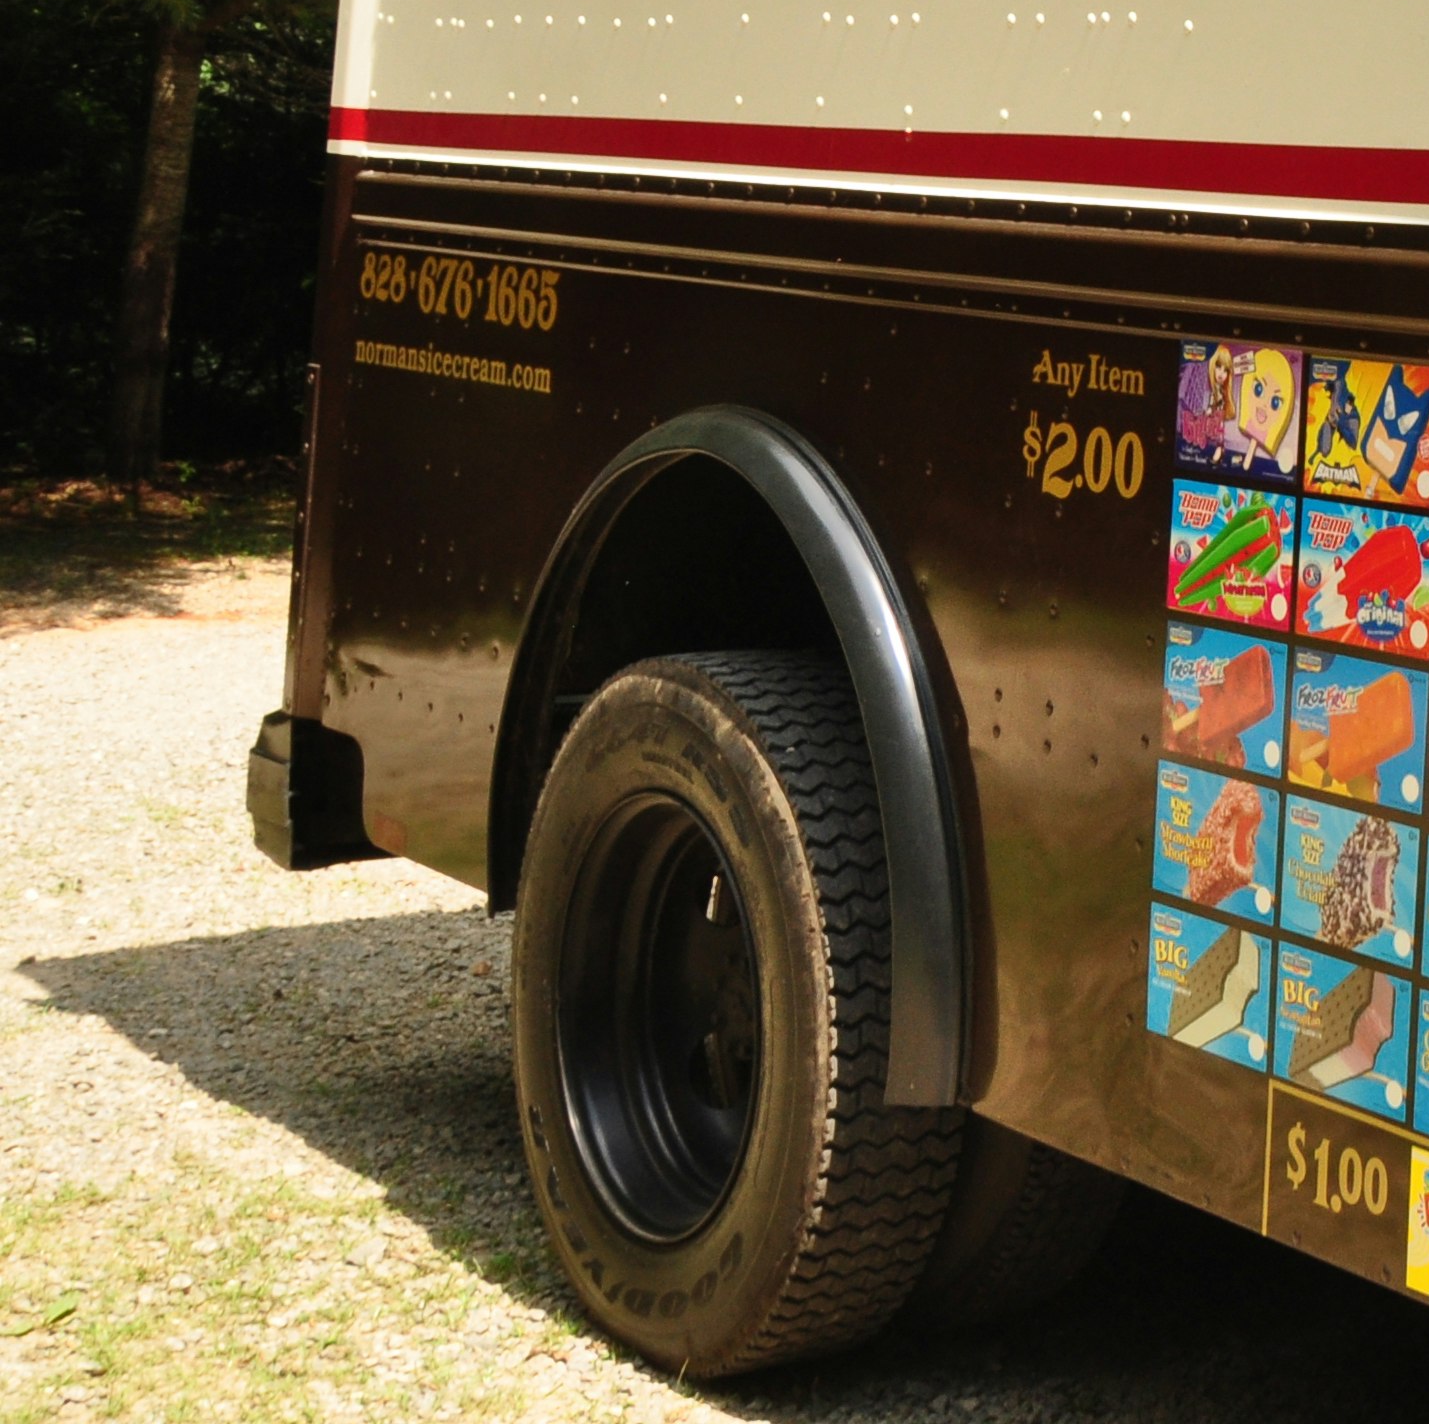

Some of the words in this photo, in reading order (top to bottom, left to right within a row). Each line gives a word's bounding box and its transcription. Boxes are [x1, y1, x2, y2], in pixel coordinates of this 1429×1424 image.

[355, 339, 551, 393] normansicecream.com
[1032, 349, 1085, 398] Any
[1087, 354, 1145, 396] Item
[1022, 410, 1144, 499] $2.00
[1313, 461, 1360, 484] BATMAN
[1312, 531, 1345, 550] POP
[1171, 796, 1191, 814] KING
[1161, 822, 1213, 849] Strawberry
[1301, 833, 1324, 852] KING
[1303, 848, 1322, 865] SIZE
[1288, 858, 1337, 886] Chocolate
[1155, 939, 1188, 969] BIG
[1283, 979, 1319, 1012] BIG
[1286, 1122, 1388, 1215] $1.00
